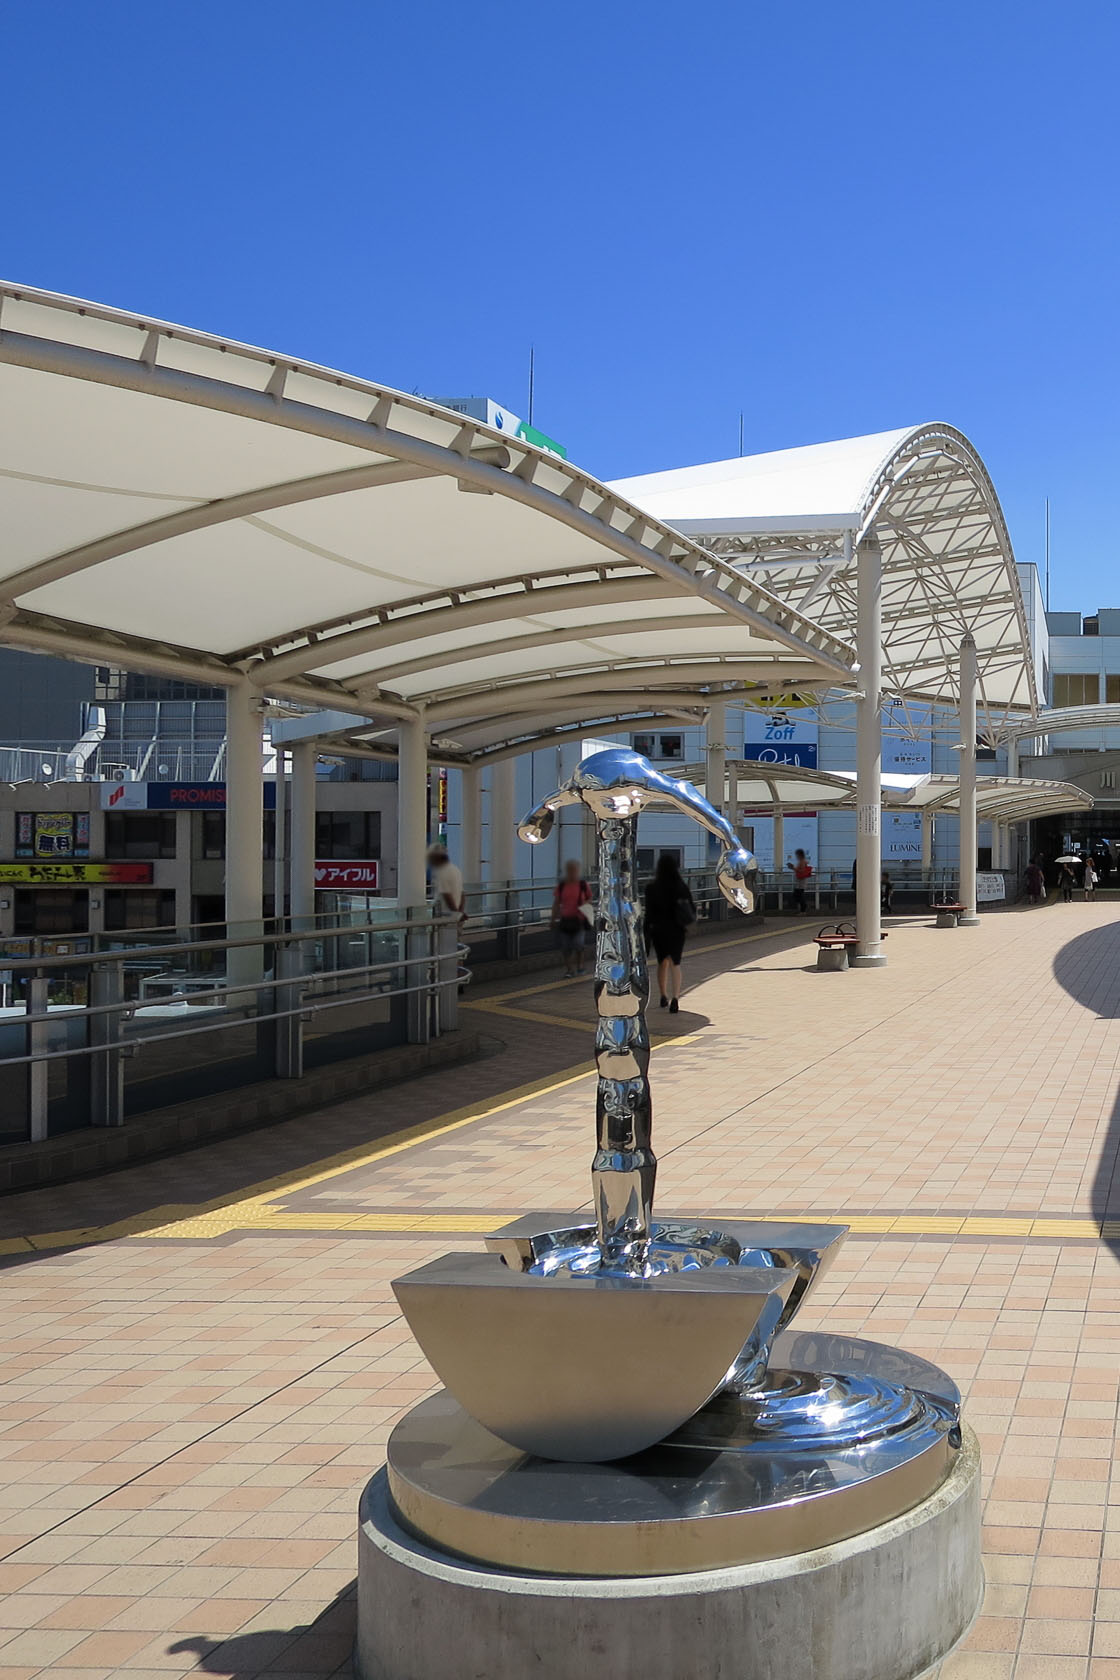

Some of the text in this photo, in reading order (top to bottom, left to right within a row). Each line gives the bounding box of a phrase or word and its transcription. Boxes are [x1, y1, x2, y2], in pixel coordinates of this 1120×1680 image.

[765, 727, 795, 740] Zoff
[170, 789, 227, 802] PROMIS
[39, 834, 70, 853] 無料
[328, 868, 375, 881] アイフル
